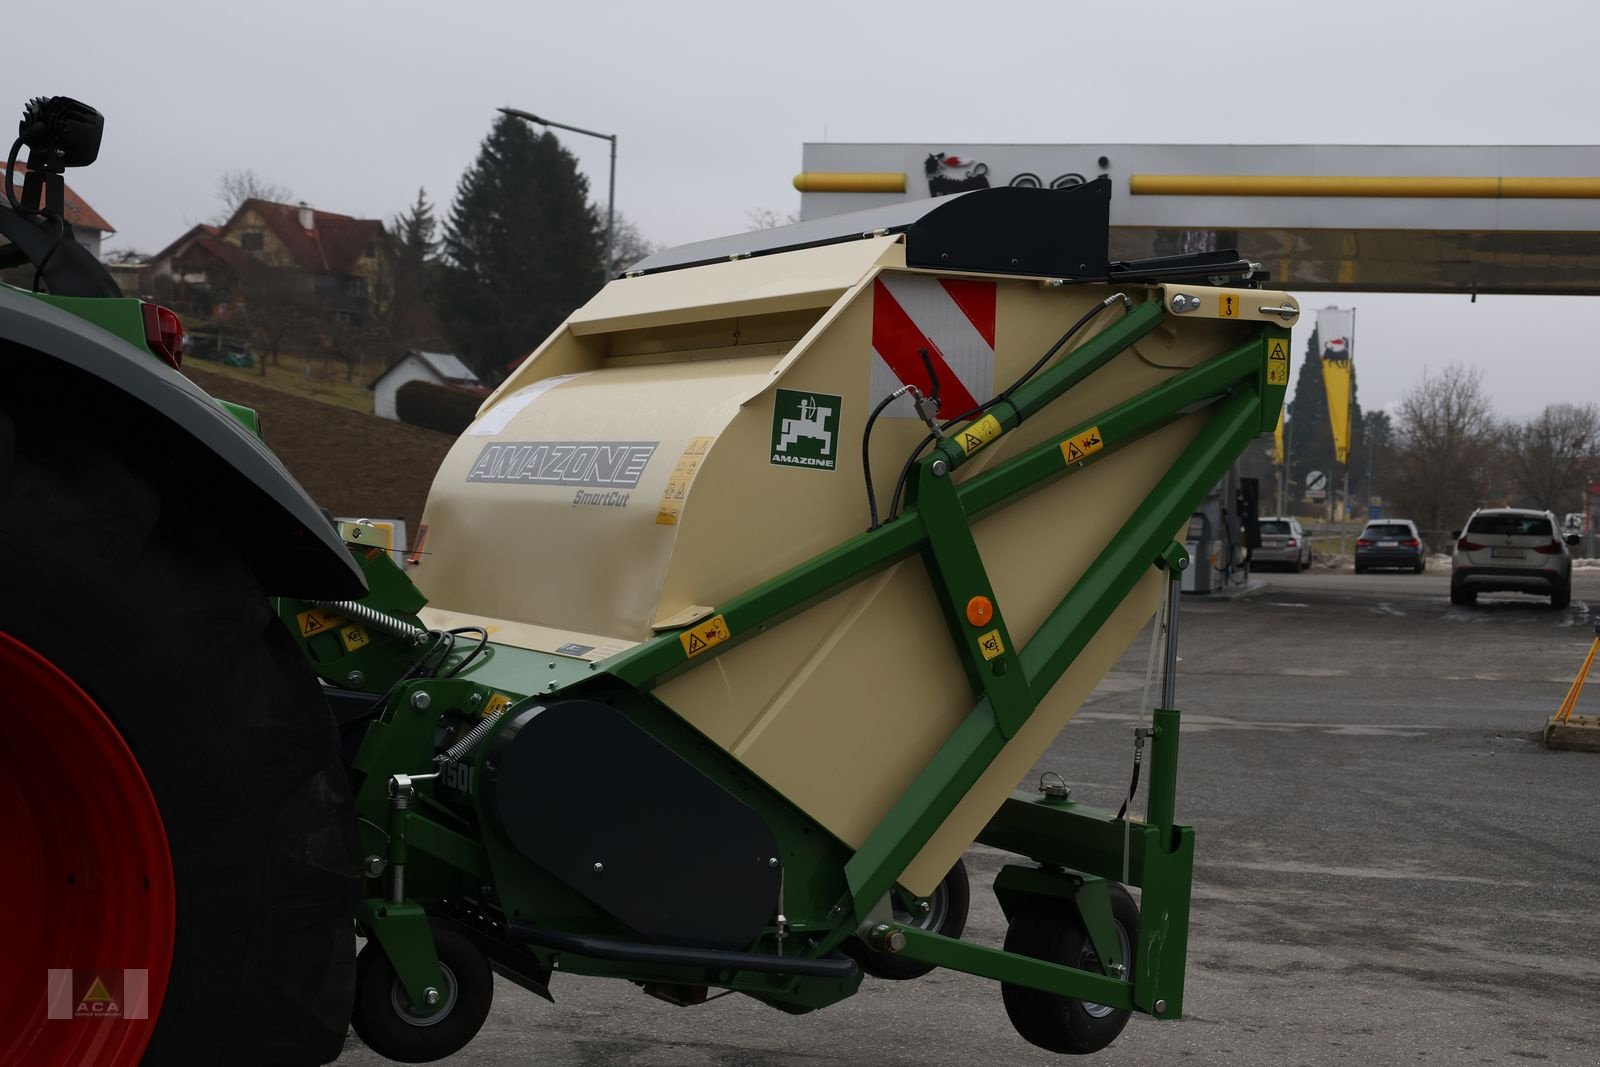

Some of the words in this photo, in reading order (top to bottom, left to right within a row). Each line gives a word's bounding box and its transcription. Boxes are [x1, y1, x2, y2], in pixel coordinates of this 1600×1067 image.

[469, 445, 655, 484] AMAZONE
[772, 454, 834, 467] AMAZONE
[573, 490, 630, 507] SmartCut
